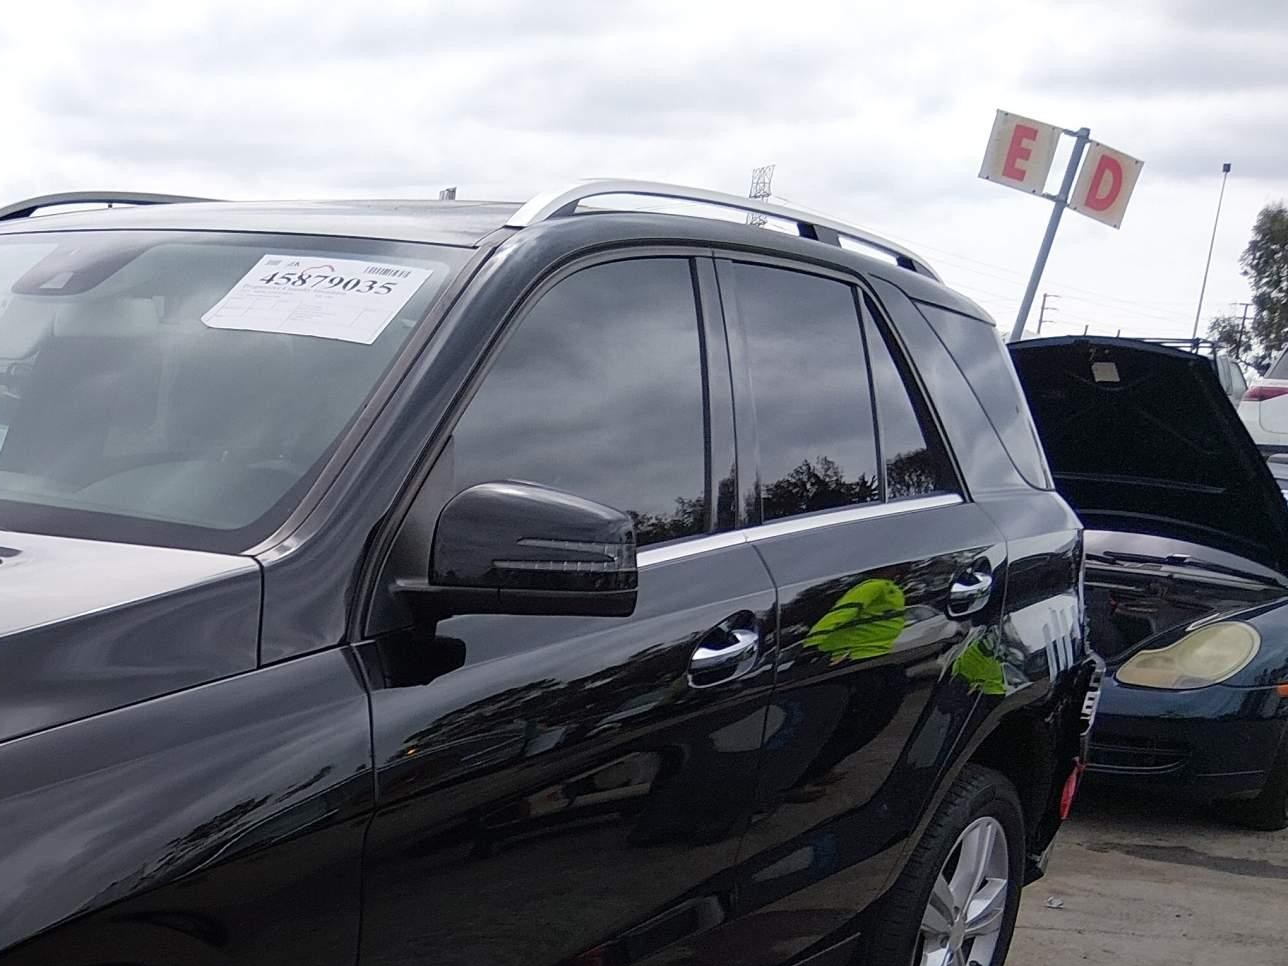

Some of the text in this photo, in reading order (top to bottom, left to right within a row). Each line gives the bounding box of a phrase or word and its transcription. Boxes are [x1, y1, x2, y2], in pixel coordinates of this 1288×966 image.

[1002, 124, 1039, 182] E
[1084, 154, 1123, 212] D
[259, 271, 398, 295] 45879035
